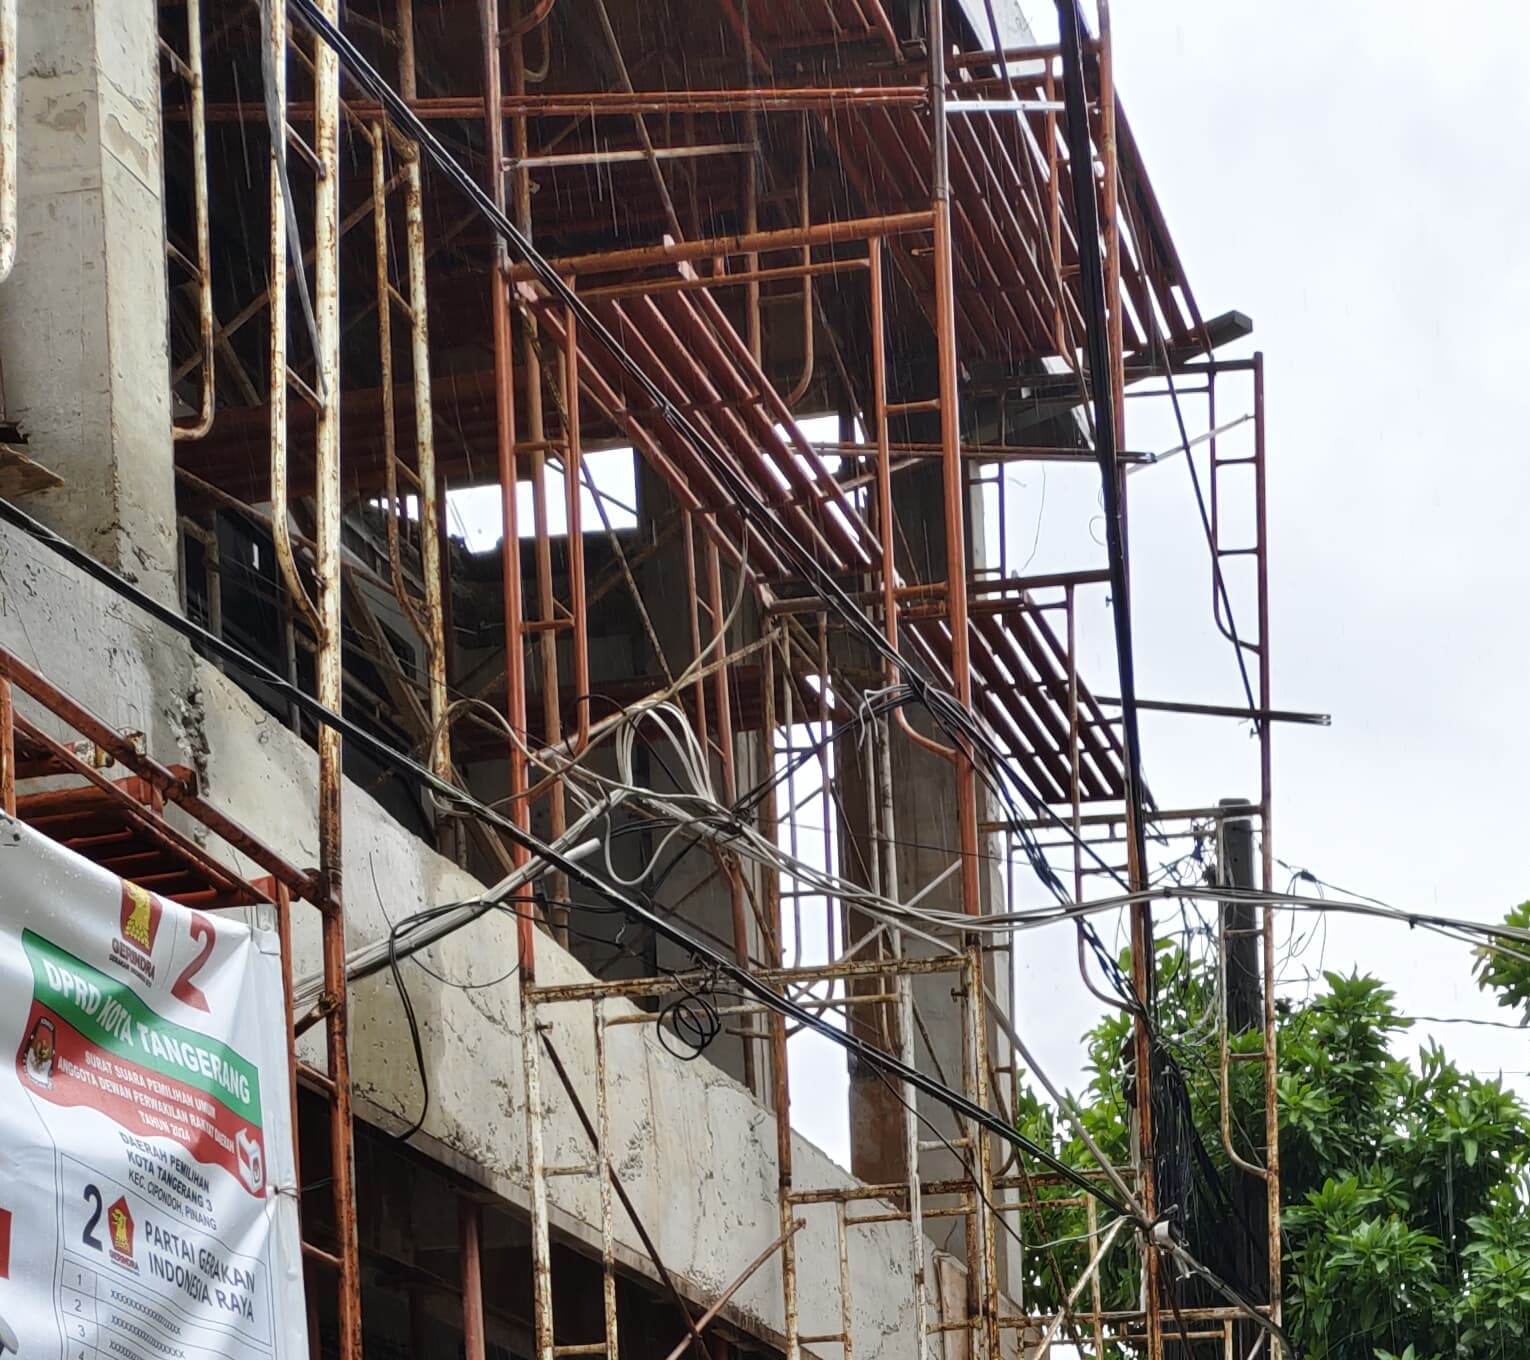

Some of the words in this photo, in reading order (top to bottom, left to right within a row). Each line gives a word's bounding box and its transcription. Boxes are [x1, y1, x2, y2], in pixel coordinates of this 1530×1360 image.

[111, 938, 155, 979] GERINDRA
[171, 912, 216, 1013] 2
[41, 958, 100, 1016] DPRD
[98, 996, 134, 1047] KOTA
[137, 1022, 251, 1105] TANGERANG
[58, 1056, 97, 1089] ANGGOTA
[99, 1077, 132, 1100] DEWAN
[133, 1090, 189, 1124] PERWAKILAN
[85, 1051, 113, 1074] SURAT
[115, 1063, 147, 1089] SUARA
[147, 1077, 193, 1108] PEMILIHAN
[138, 1111, 169, 1134] TAHUN
[119, 1131, 167, 1164] DAERAH
[170, 1155, 210, 1193] PEMILIHAN
[126, 1150, 155, 1176] KOTA
[157, 1165, 204, 1208] TANGERANG
[205, 1198, 213, 1213] 3
[83, 1183, 103, 1252] 2
[128, 1170, 146, 1191] KEC.
[148, 1182, 184, 1217] CIPONDOH,
[184, 1207, 217, 1231] PINANG
[145, 1220, 196, 1265] PARTAI
[199, 1249, 255, 1294] GERAKAN
[148, 1251, 212, 1307] INDONESIA
[216, 1289, 254, 1323] RAYA
[74, 1300, 82, 1312] 2
[78, 1325, 86, 1338] 3
